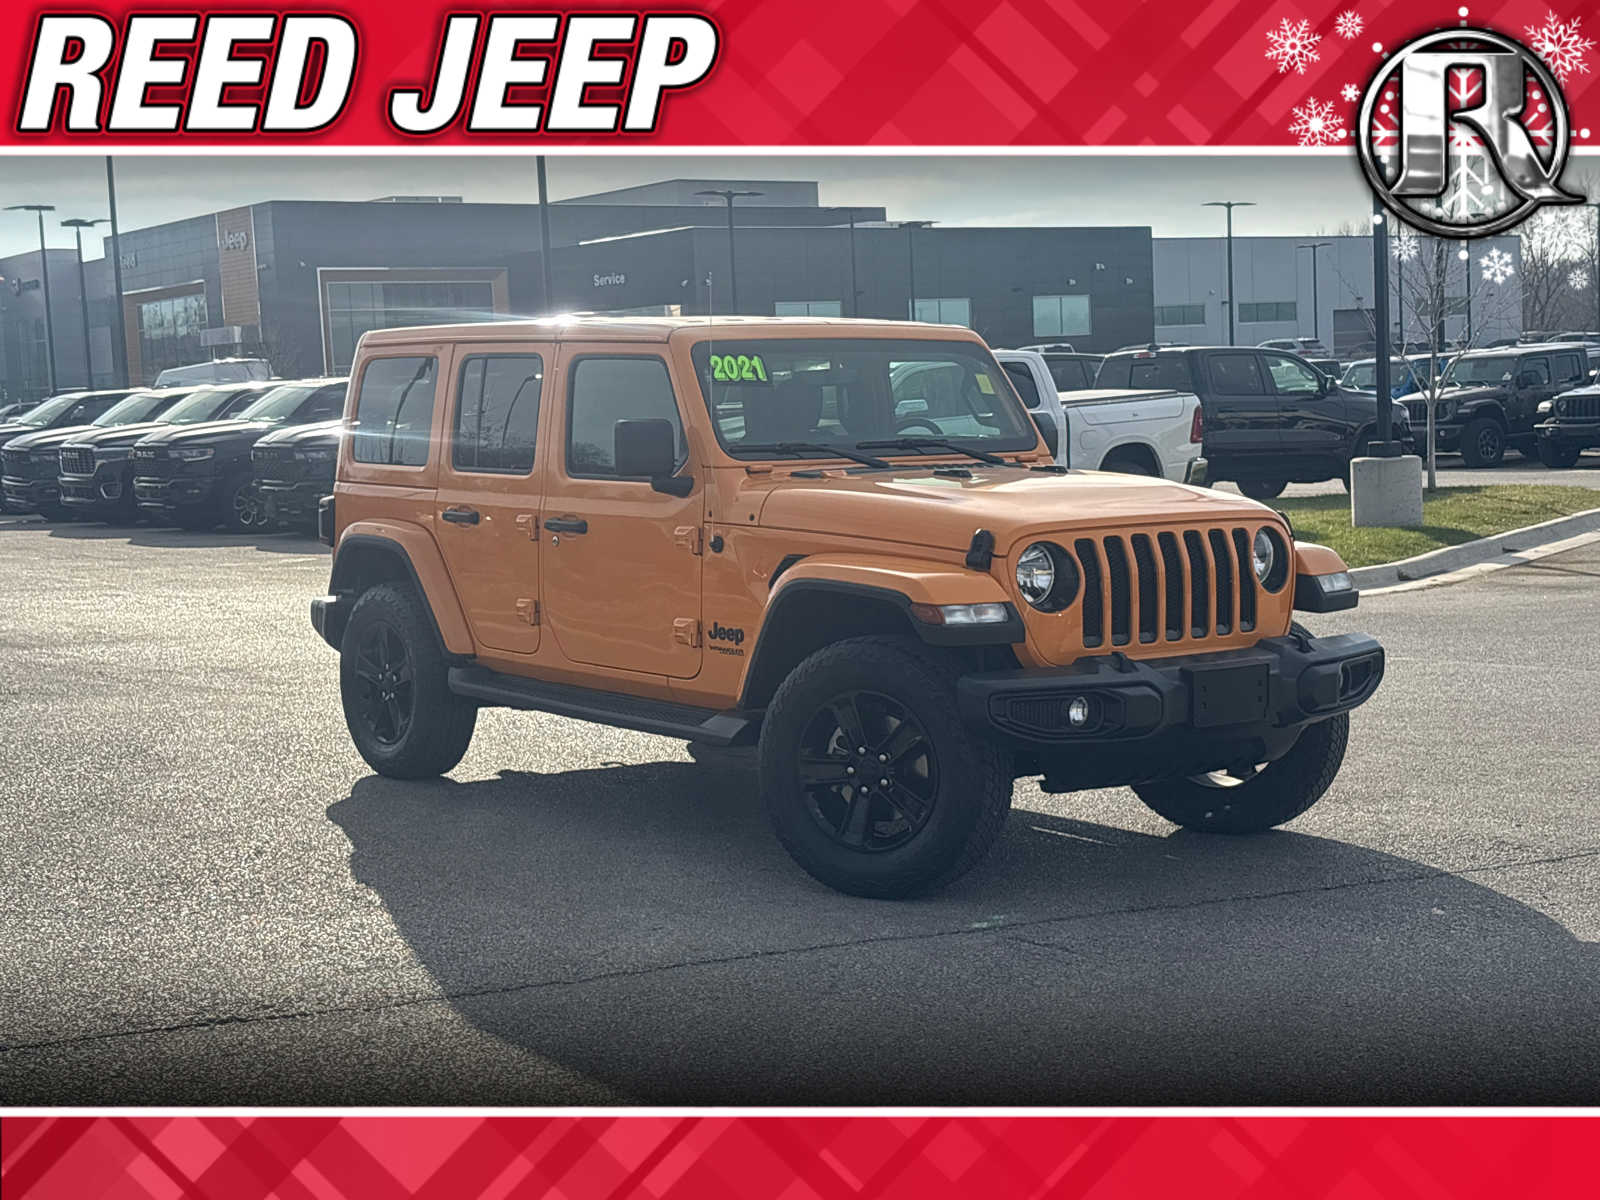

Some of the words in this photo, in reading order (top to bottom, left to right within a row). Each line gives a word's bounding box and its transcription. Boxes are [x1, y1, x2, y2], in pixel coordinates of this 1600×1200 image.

[221, 230, 248, 250] Jeep
[593, 272, 625, 286] Service
[710, 354, 768, 382] 2021
[708, 621, 745, 646] Jeep
